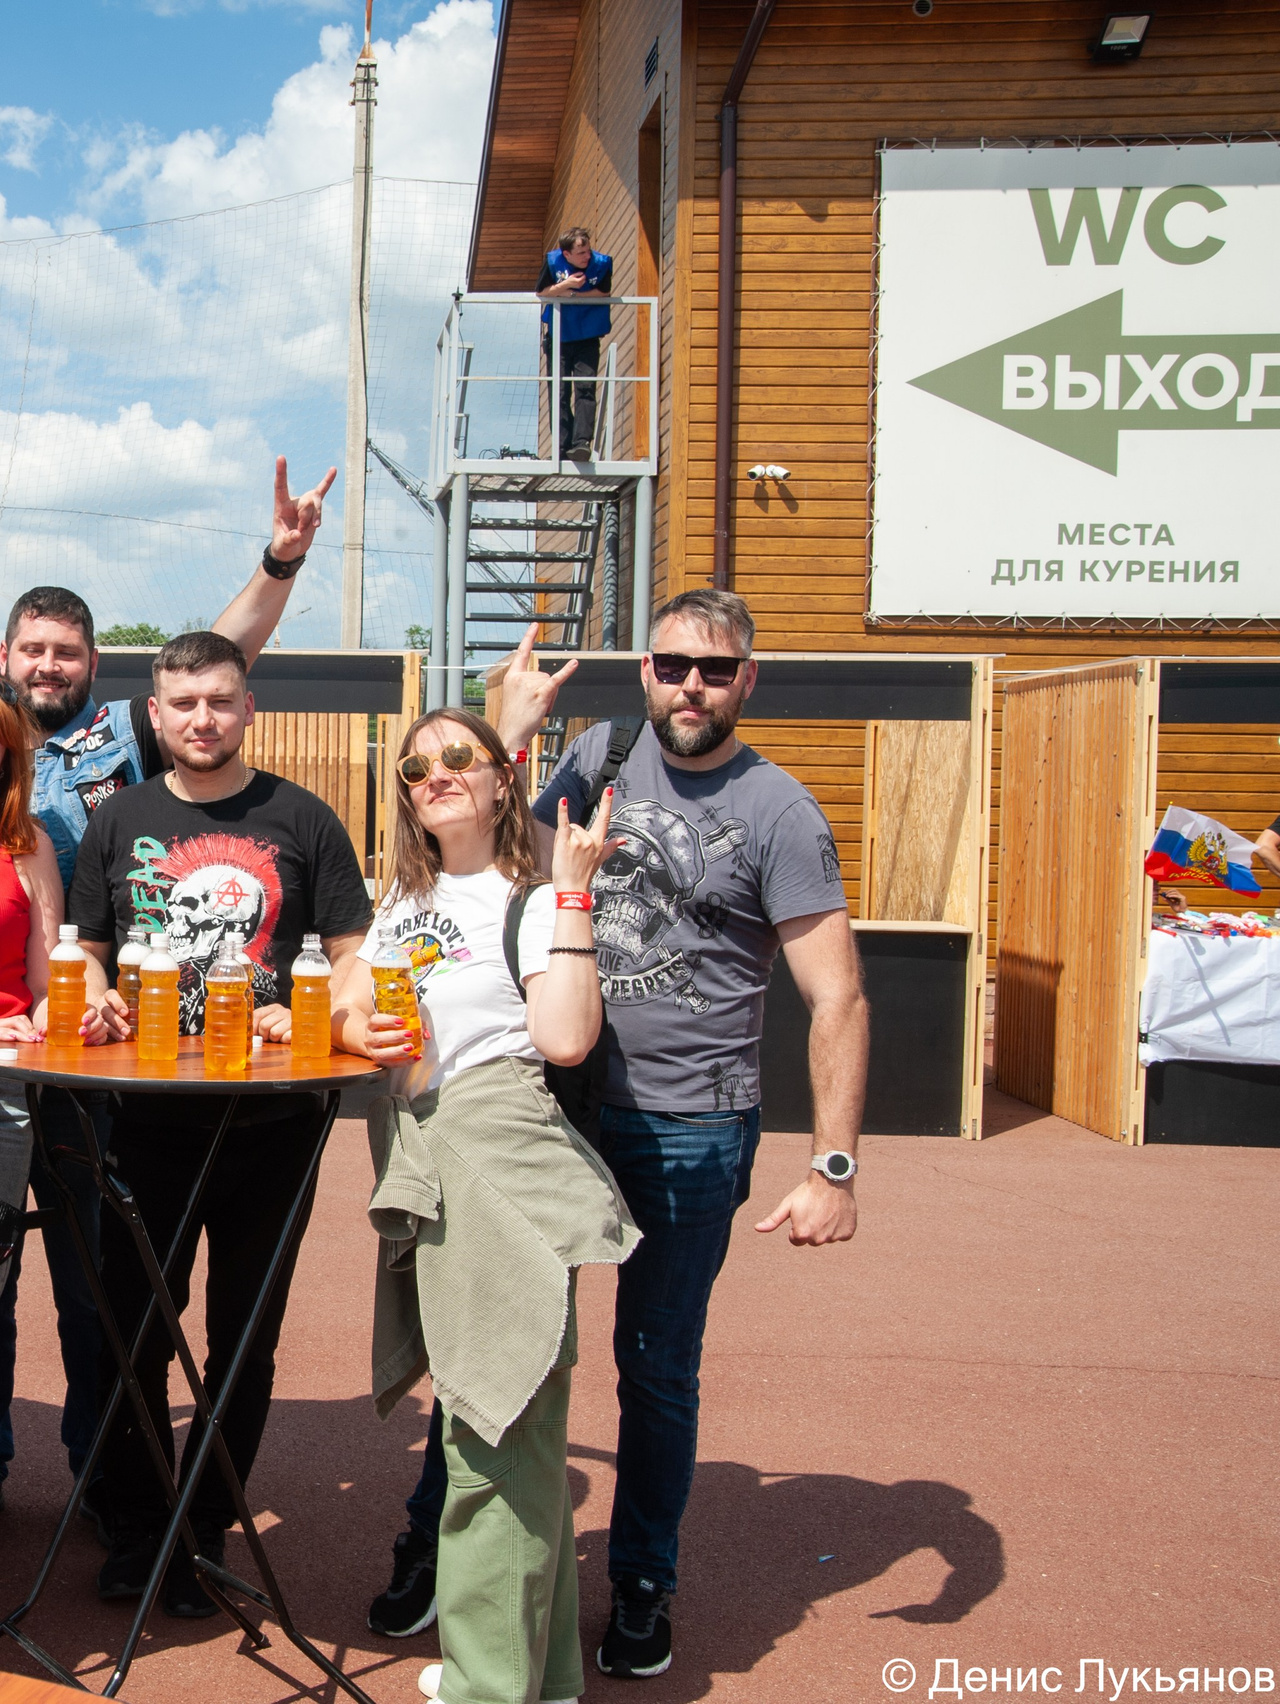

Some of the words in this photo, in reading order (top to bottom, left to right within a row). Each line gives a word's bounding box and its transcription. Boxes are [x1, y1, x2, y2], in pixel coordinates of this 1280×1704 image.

[1028, 184, 1228, 266] WC
[1002, 353, 1280, 421] ВЫХОД
[1058, 523, 1175, 546] МЕСТА
[991, 559, 1064, 586] ДЛЯ
[1079, 559, 1240, 583] КУРЕНИЯ
[83, 780, 116, 809] PUNKS
[126, 836, 172, 935] DEAD
[598, 950, 624, 972] LIVE
[609, 959, 689, 1002] REGRETS
